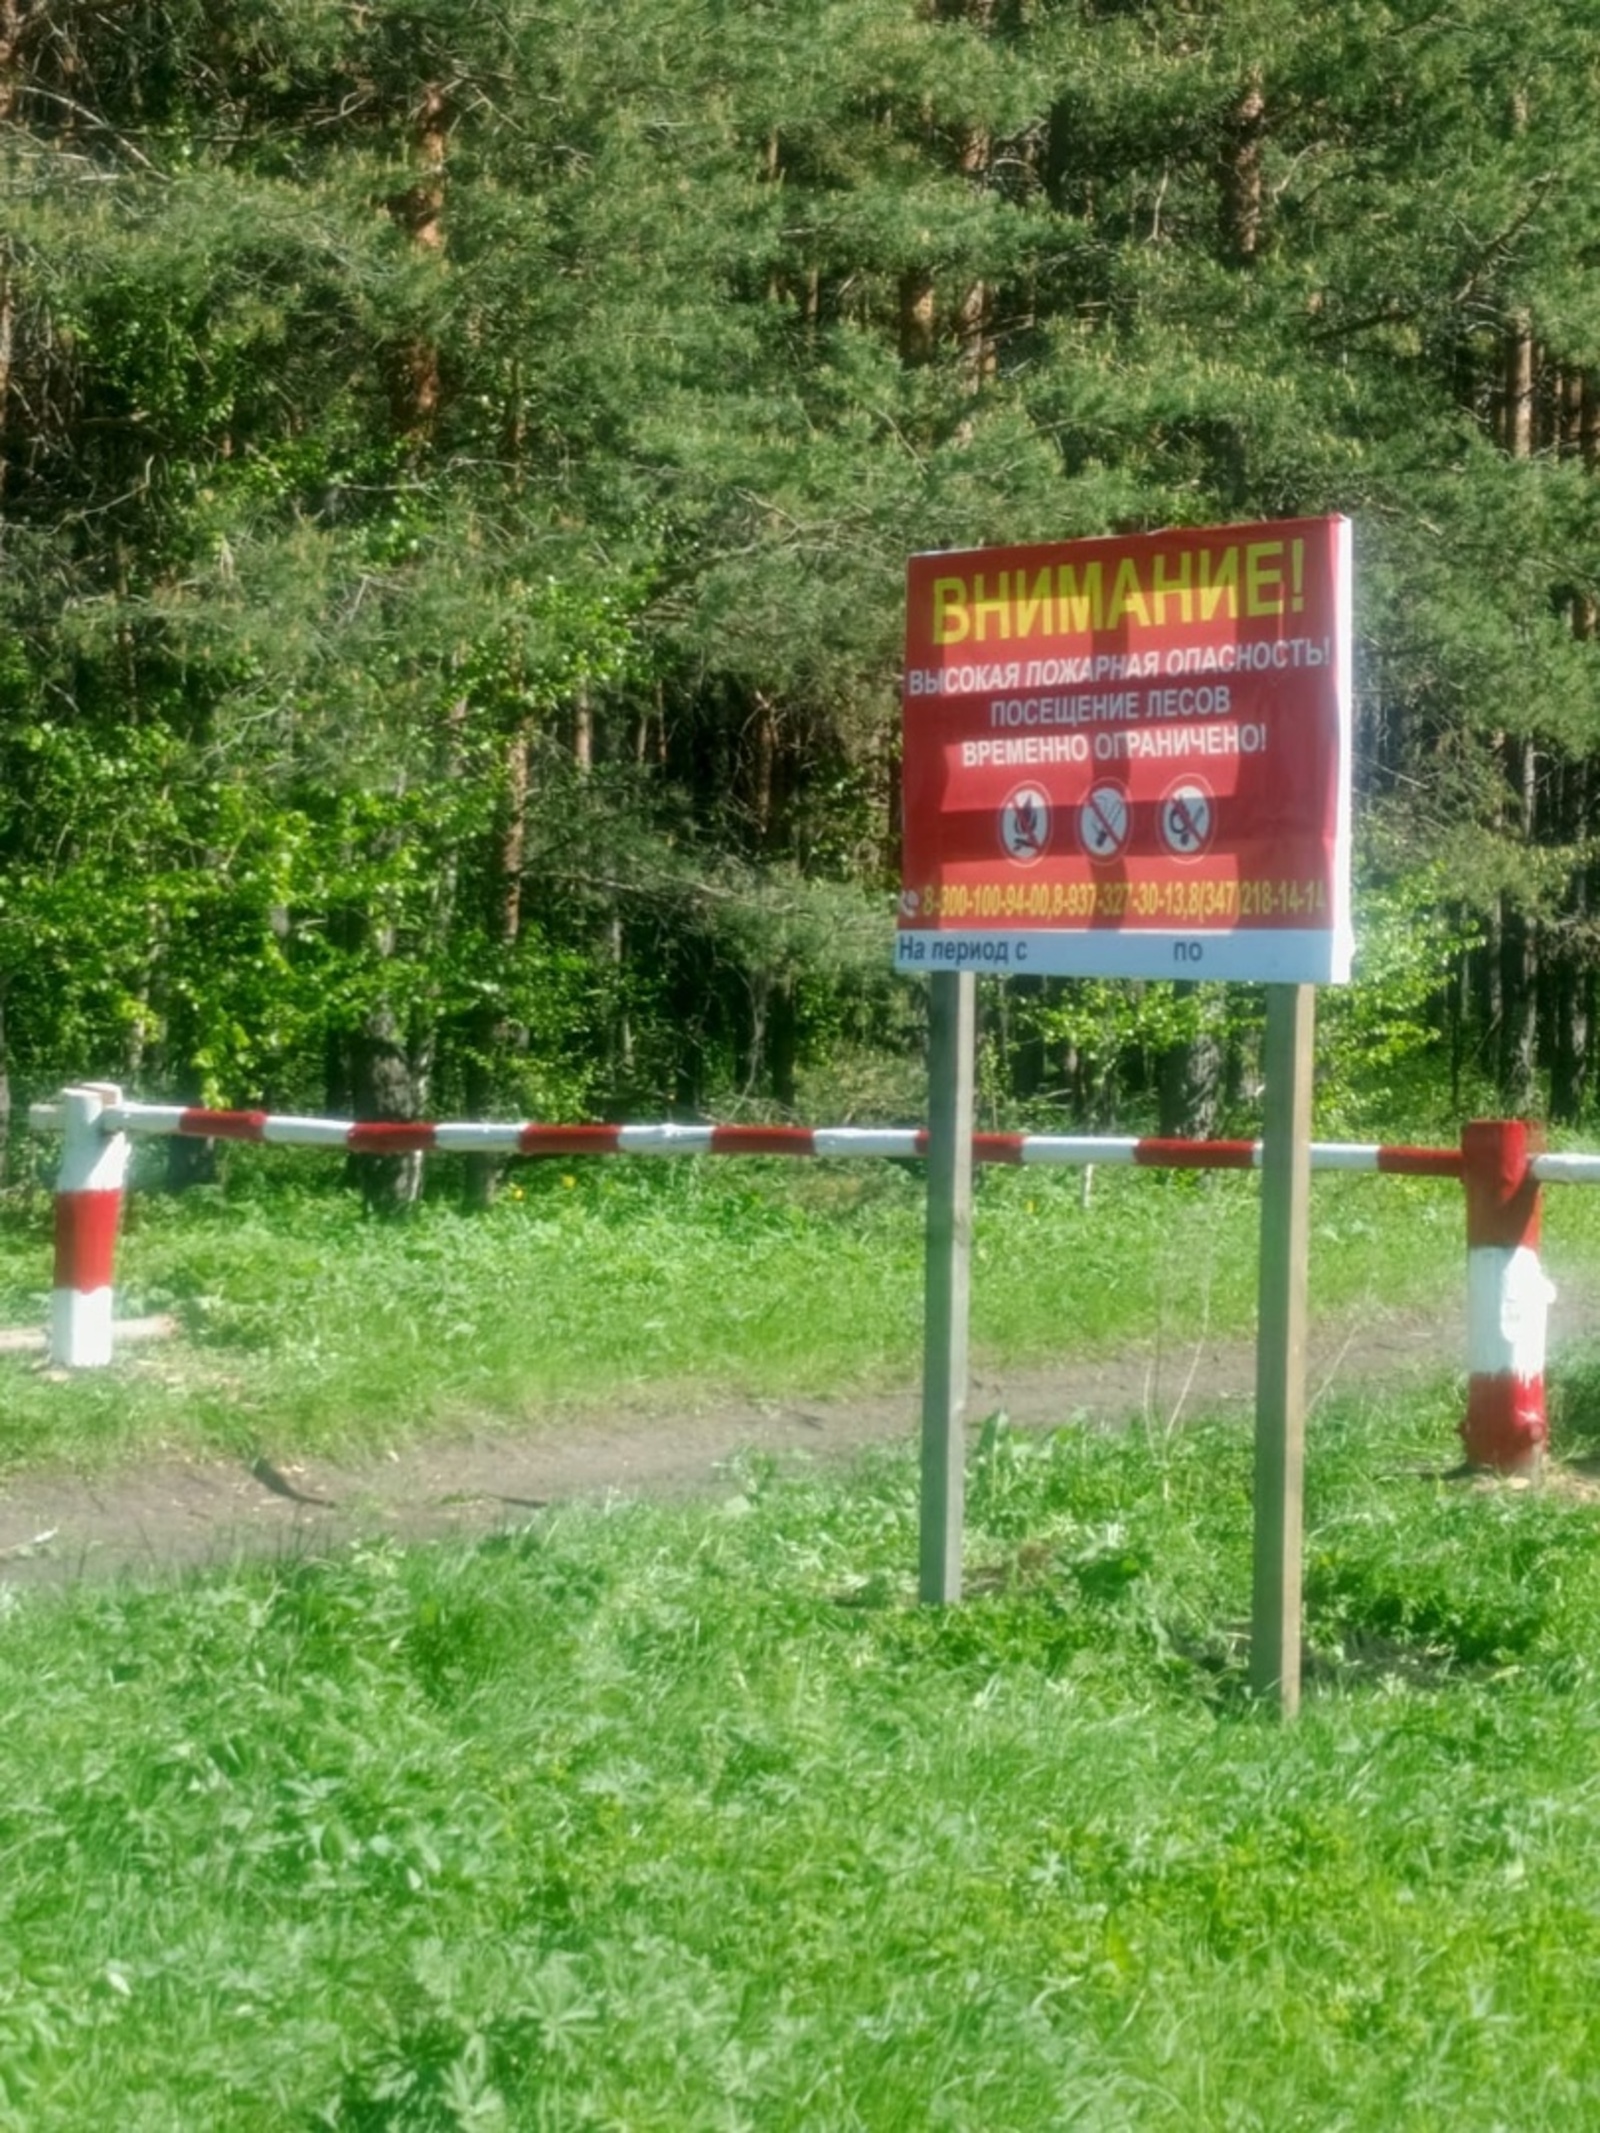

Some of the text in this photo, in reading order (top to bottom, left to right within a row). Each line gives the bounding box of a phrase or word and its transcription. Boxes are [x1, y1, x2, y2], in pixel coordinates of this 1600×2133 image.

[932, 538, 1305, 646] ВНИМАНИЕ!
[909, 637, 1331, 696] ВЫСОКАЯ ПОЖАРНАЯ ОПАСНОСТЬ!
[990, 685, 1232, 728] ПОСЕЩЕНИЕ ЛЕСОВ
[962, 723, 1267, 767] ВРЕМЕННО ОГРАНИЧЕНО!
[900, 932, 1028, 965] На период с
[1173, 940, 1204, 962] по
